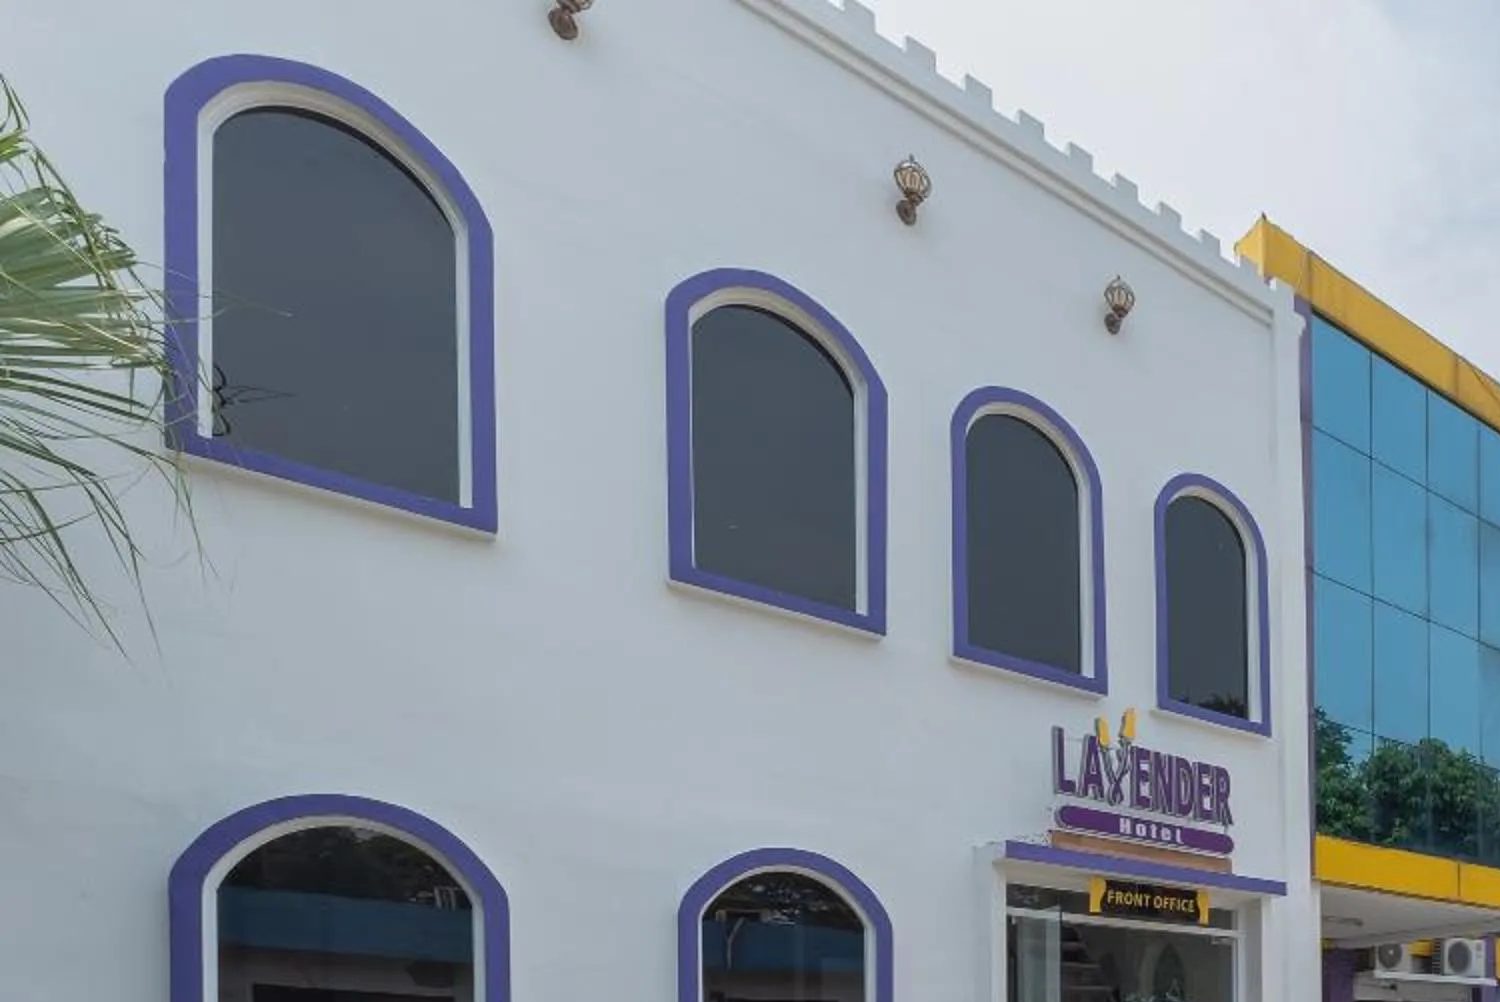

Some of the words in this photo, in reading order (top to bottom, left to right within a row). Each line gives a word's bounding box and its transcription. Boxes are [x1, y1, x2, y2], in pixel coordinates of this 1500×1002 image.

[1052, 715, 1234, 827] LAVENDER
[1118, 816, 1185, 846] Hotel
[1106, 889, 1151, 907] FRONT
[1153, 895, 1195, 913] OFFICE
